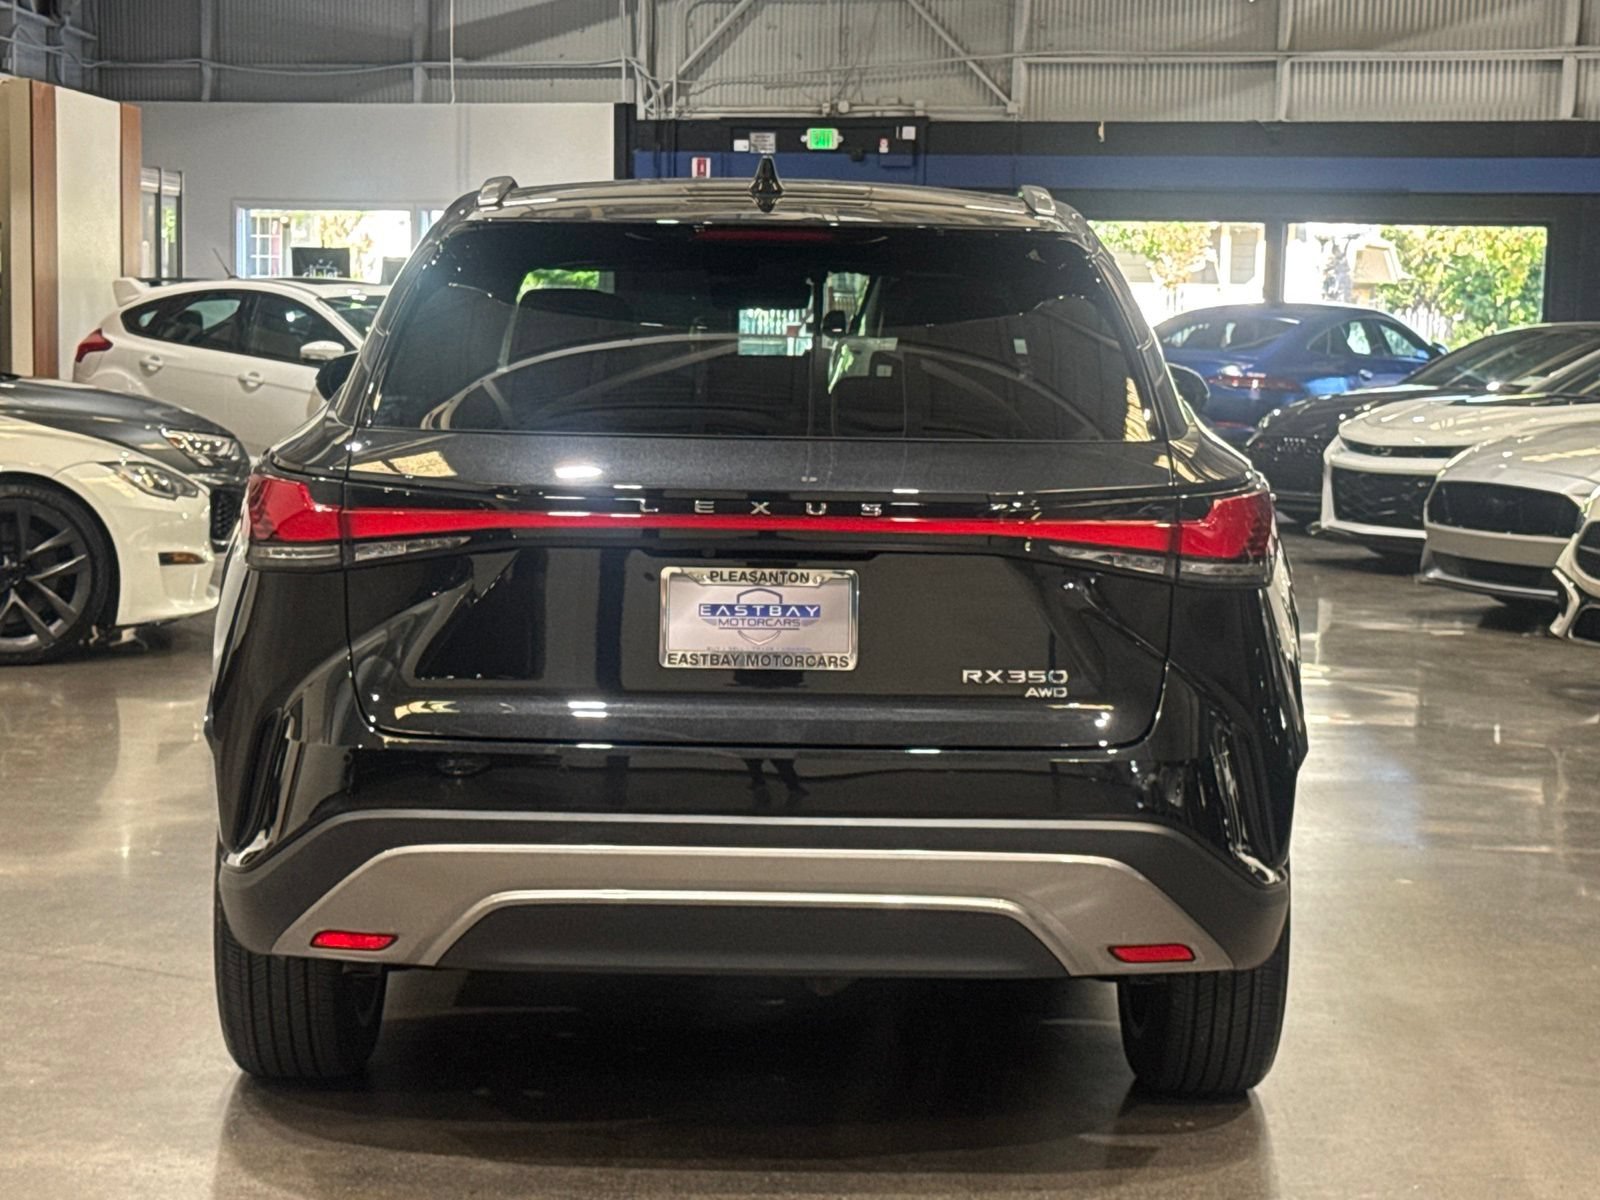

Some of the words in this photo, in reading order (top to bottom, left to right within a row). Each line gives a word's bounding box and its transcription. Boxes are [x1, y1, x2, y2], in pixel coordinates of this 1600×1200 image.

[639, 500, 882, 516] LEXUS
[709, 571, 810, 584] PLEASANTON
[700, 605, 819, 617] EASTBAY
[718, 618, 801, 628] MOTORCARS
[667, 652, 740, 667] EASTBAY
[746, 653, 850, 669] MOTORCARS
[1024, 686, 1068, 698] AWD
